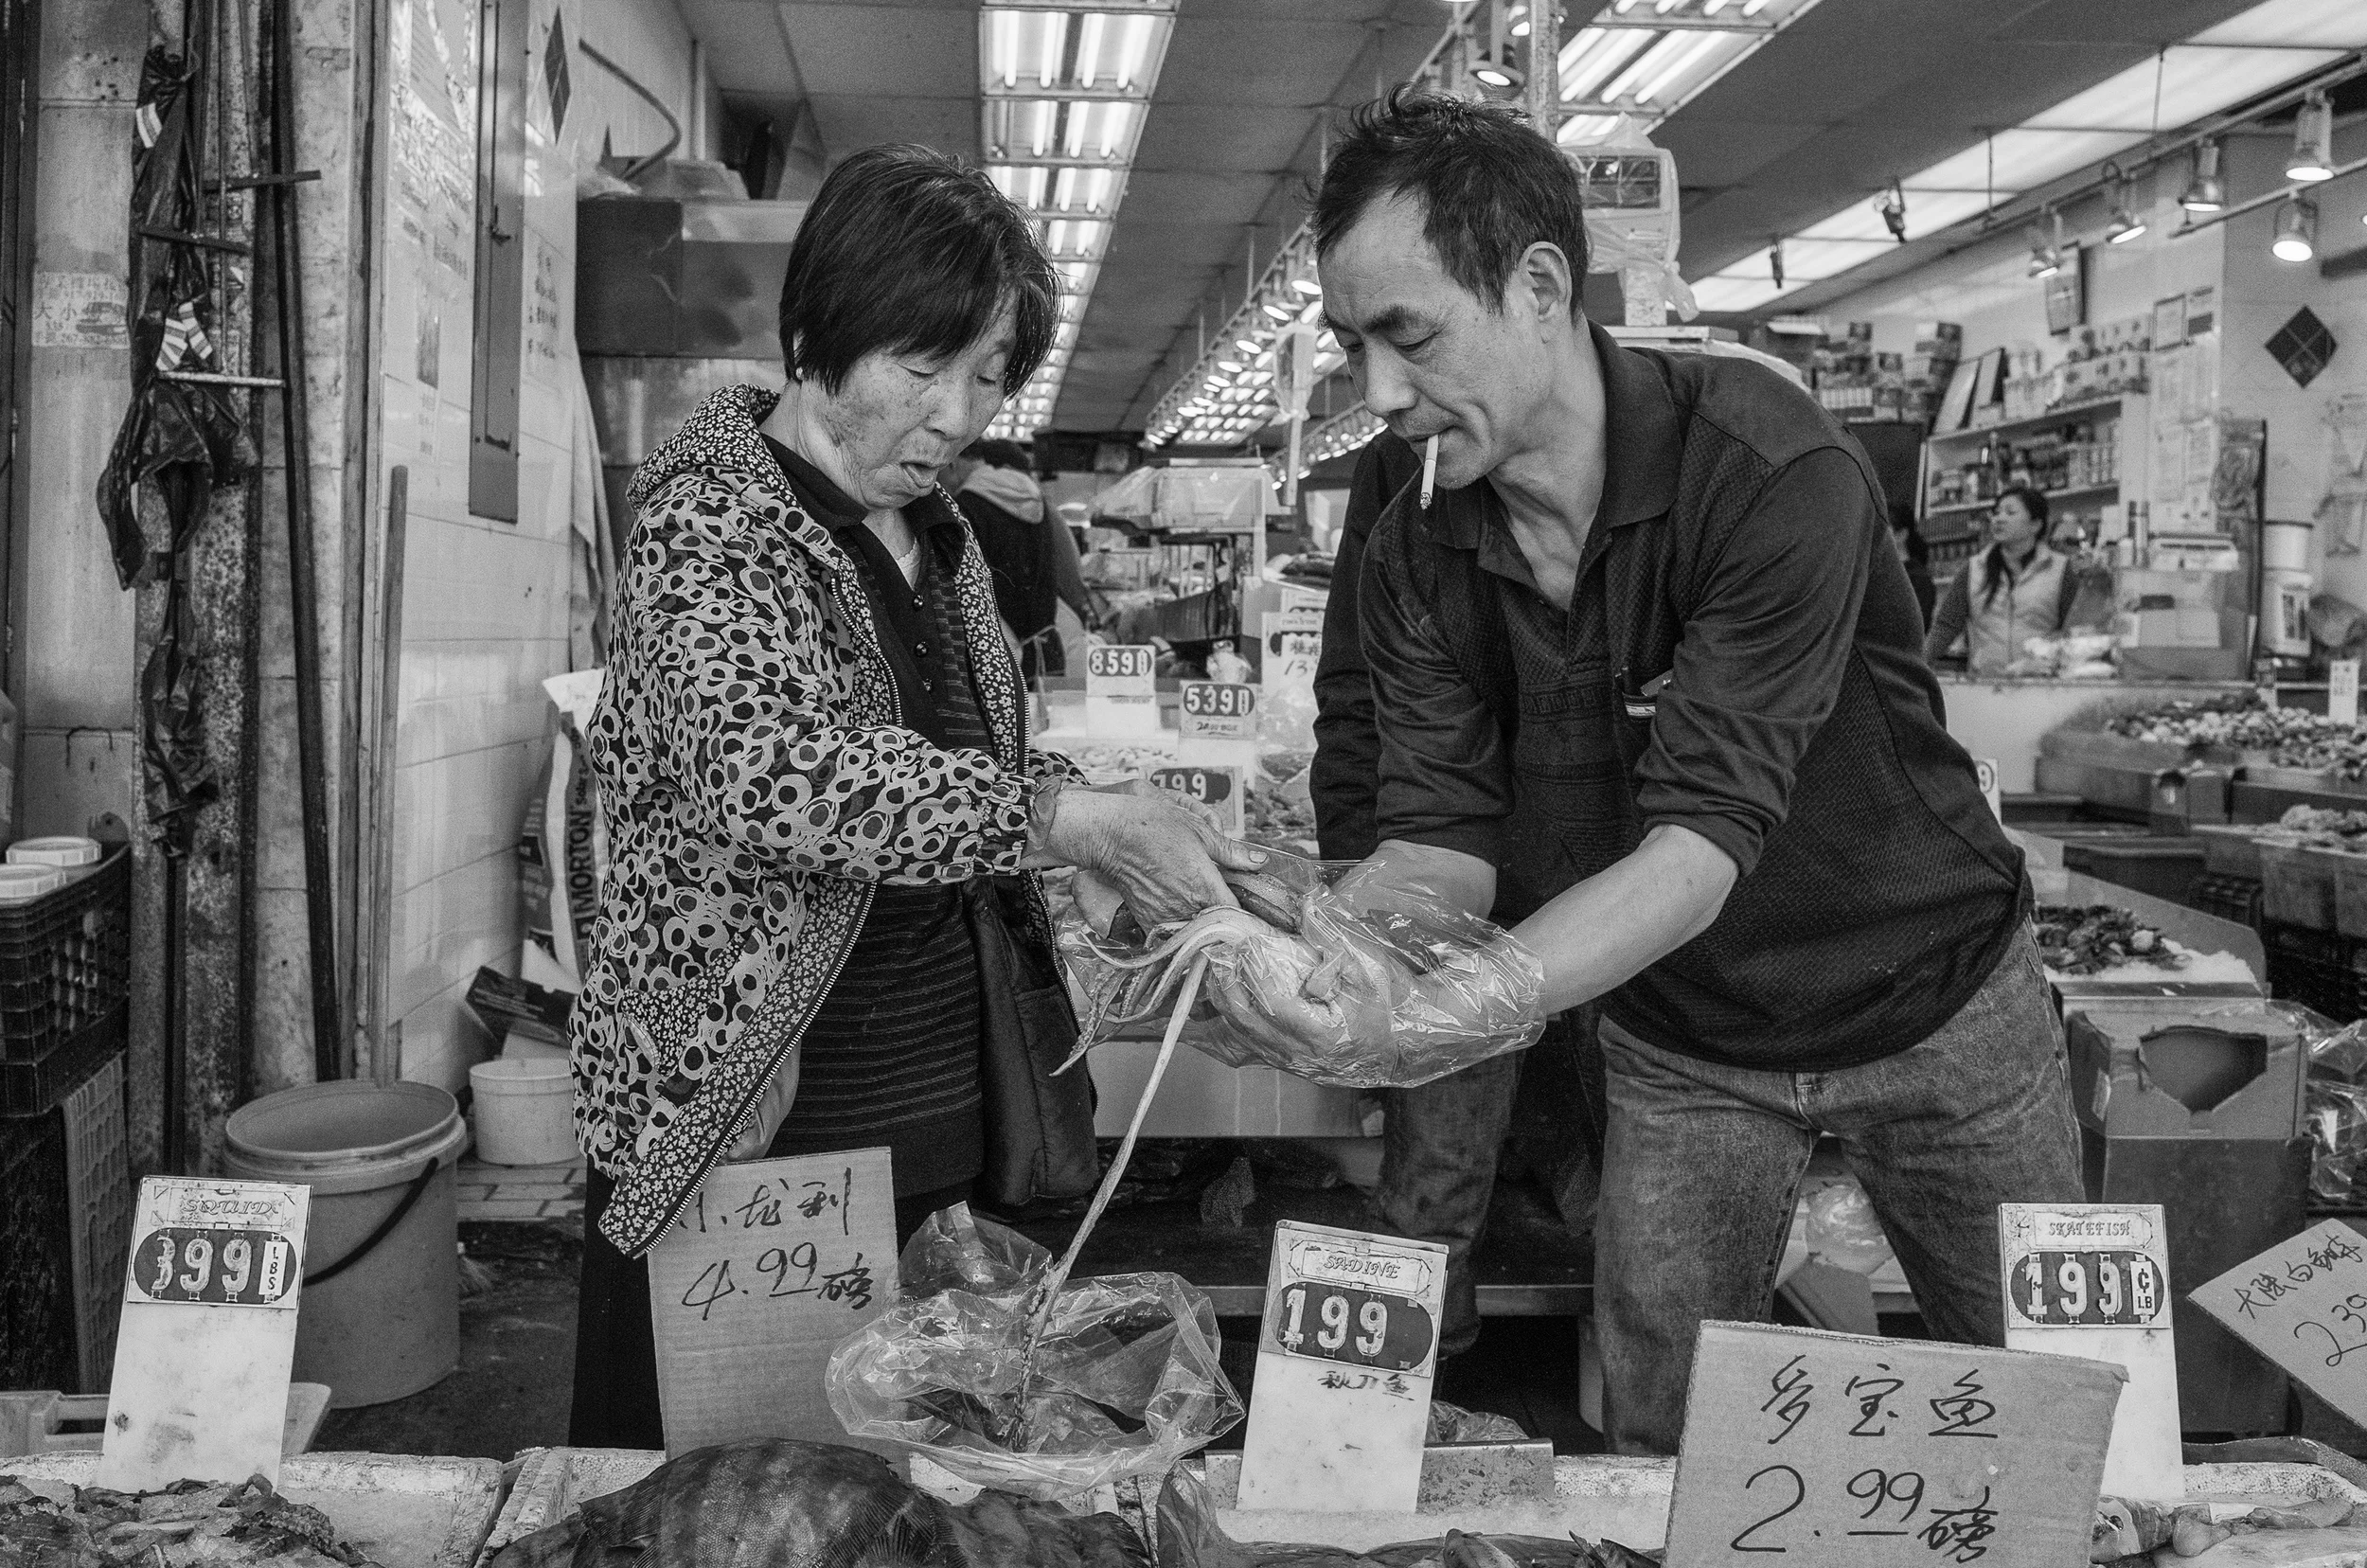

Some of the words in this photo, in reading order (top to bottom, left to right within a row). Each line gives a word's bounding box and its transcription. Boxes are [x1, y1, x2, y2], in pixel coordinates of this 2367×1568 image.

[568, 810, 595, 915] MORTON
[182, 1199, 279, 1216] SQUID
[2048, 1221, 2131, 1238] SKATEFISH
[1323, 1254, 1401, 1279] SADINE
[2025, 1261, 2123, 1315] 199
[1284, 1289, 1388, 1357] 199
